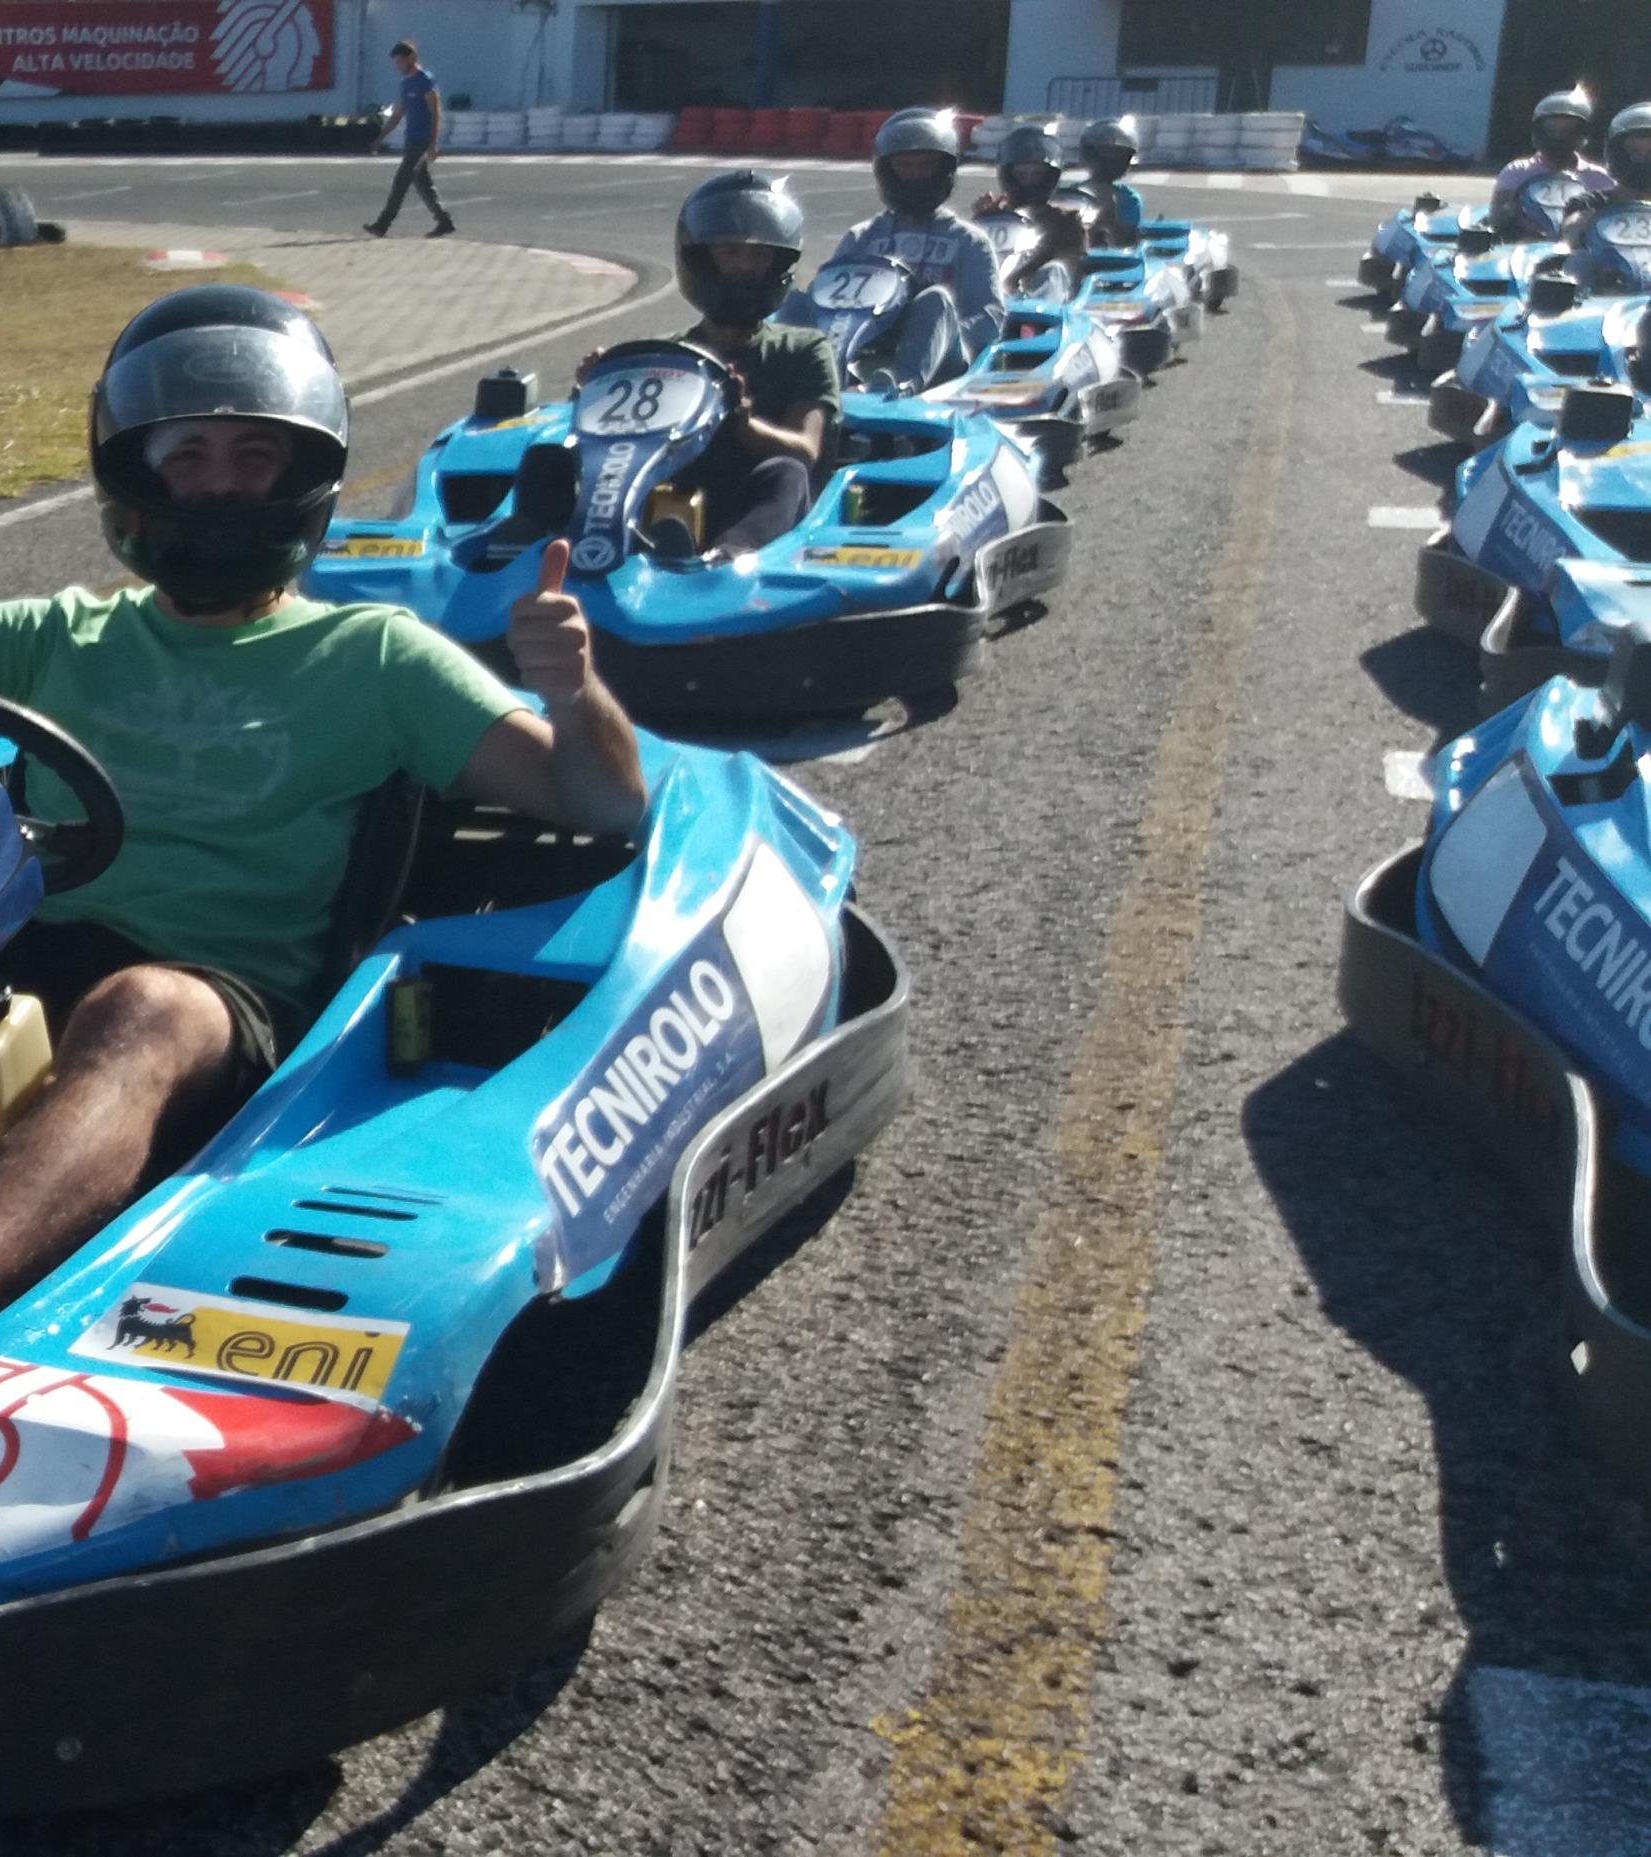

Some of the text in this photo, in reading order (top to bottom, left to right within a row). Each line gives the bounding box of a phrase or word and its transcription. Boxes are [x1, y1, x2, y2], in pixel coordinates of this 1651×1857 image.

[61, 21, 199, 48] MAQUINAÇÃO
[12, 52, 195, 72] ALTA VELOCIDADE
[1613, 219, 1650, 239] 23
[828, 272, 872, 301] 27
[599, 377, 664, 421] 28
[539, 958, 736, 1219] TECNIROLO
[216, 1330, 381, 1393] eni
